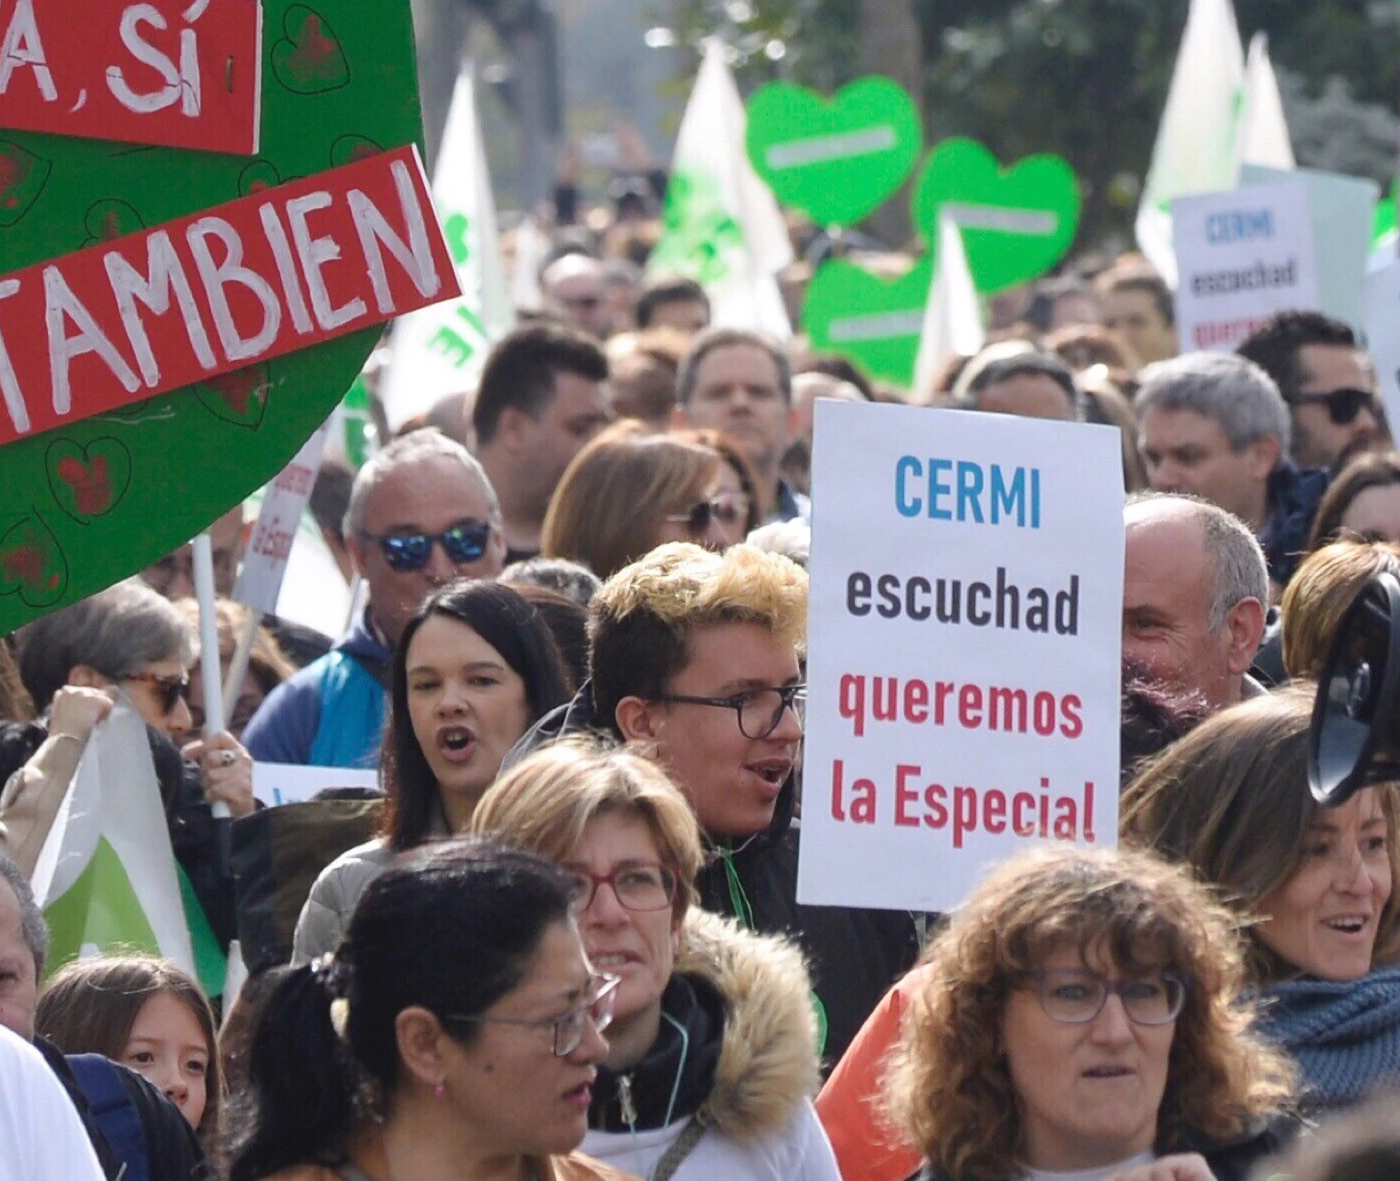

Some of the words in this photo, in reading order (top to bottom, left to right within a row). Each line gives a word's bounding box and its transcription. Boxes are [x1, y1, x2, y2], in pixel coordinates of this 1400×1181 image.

[1205, 209, 1272, 246] CERMI
[895, 456, 1040, 528] CERMI
[846, 567, 1080, 636] escuchad
[839, 672, 1084, 738] queremos
[830, 759, 877, 824] la
[894, 764, 1096, 848] Especial
